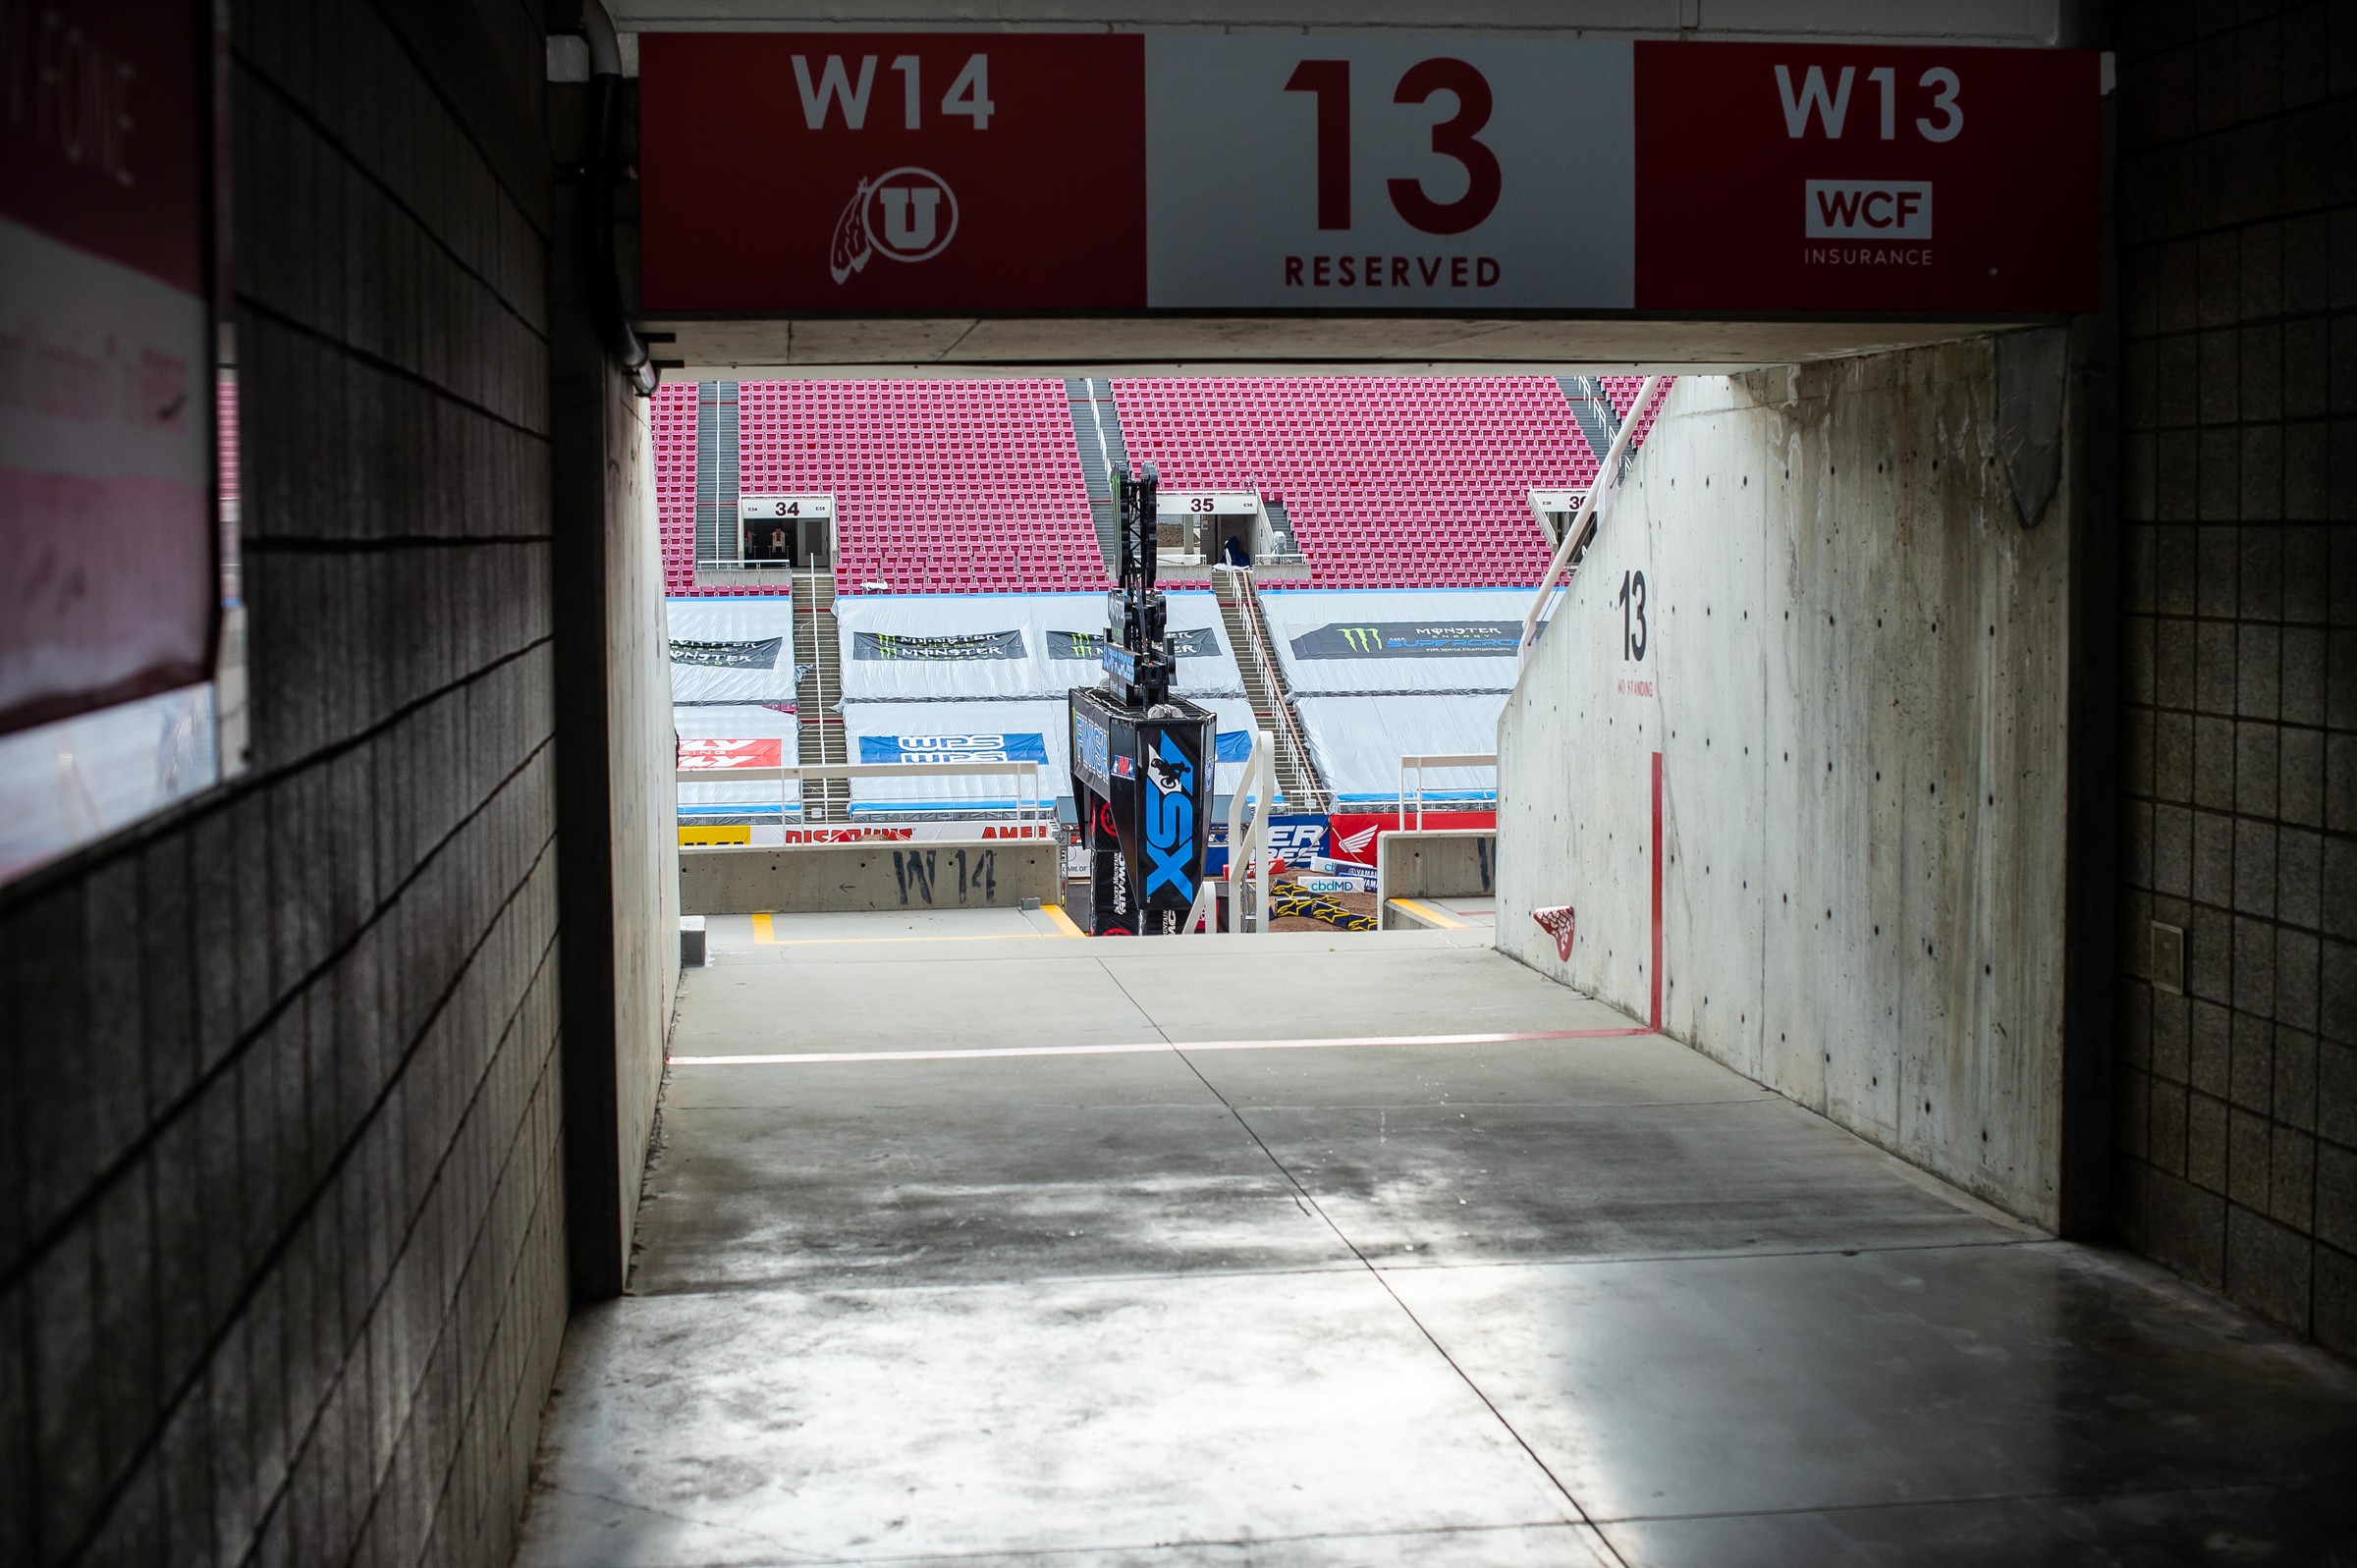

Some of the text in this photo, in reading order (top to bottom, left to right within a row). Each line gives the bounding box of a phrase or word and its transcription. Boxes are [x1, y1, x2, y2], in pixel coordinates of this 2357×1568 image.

[791, 54, 995, 130] W14
[1774, 65, 1964, 143] W13
[1284, 57, 1503, 236] 13
[1817, 190, 1922, 229] WCF
[1285, 255, 1502, 288] RESERVED
[1804, 248, 1934, 266] INSURANCE
[775, 502, 800, 516] 34
[1190, 498, 1215, 513] 35
[1415, 626, 1503, 636] MONSTER
[1618, 569, 1647, 662] 13
[899, 735, 1005, 751] WPS
[955, 848, 998, 904] 14
[1310, 880, 1353, 892] cbdMD
